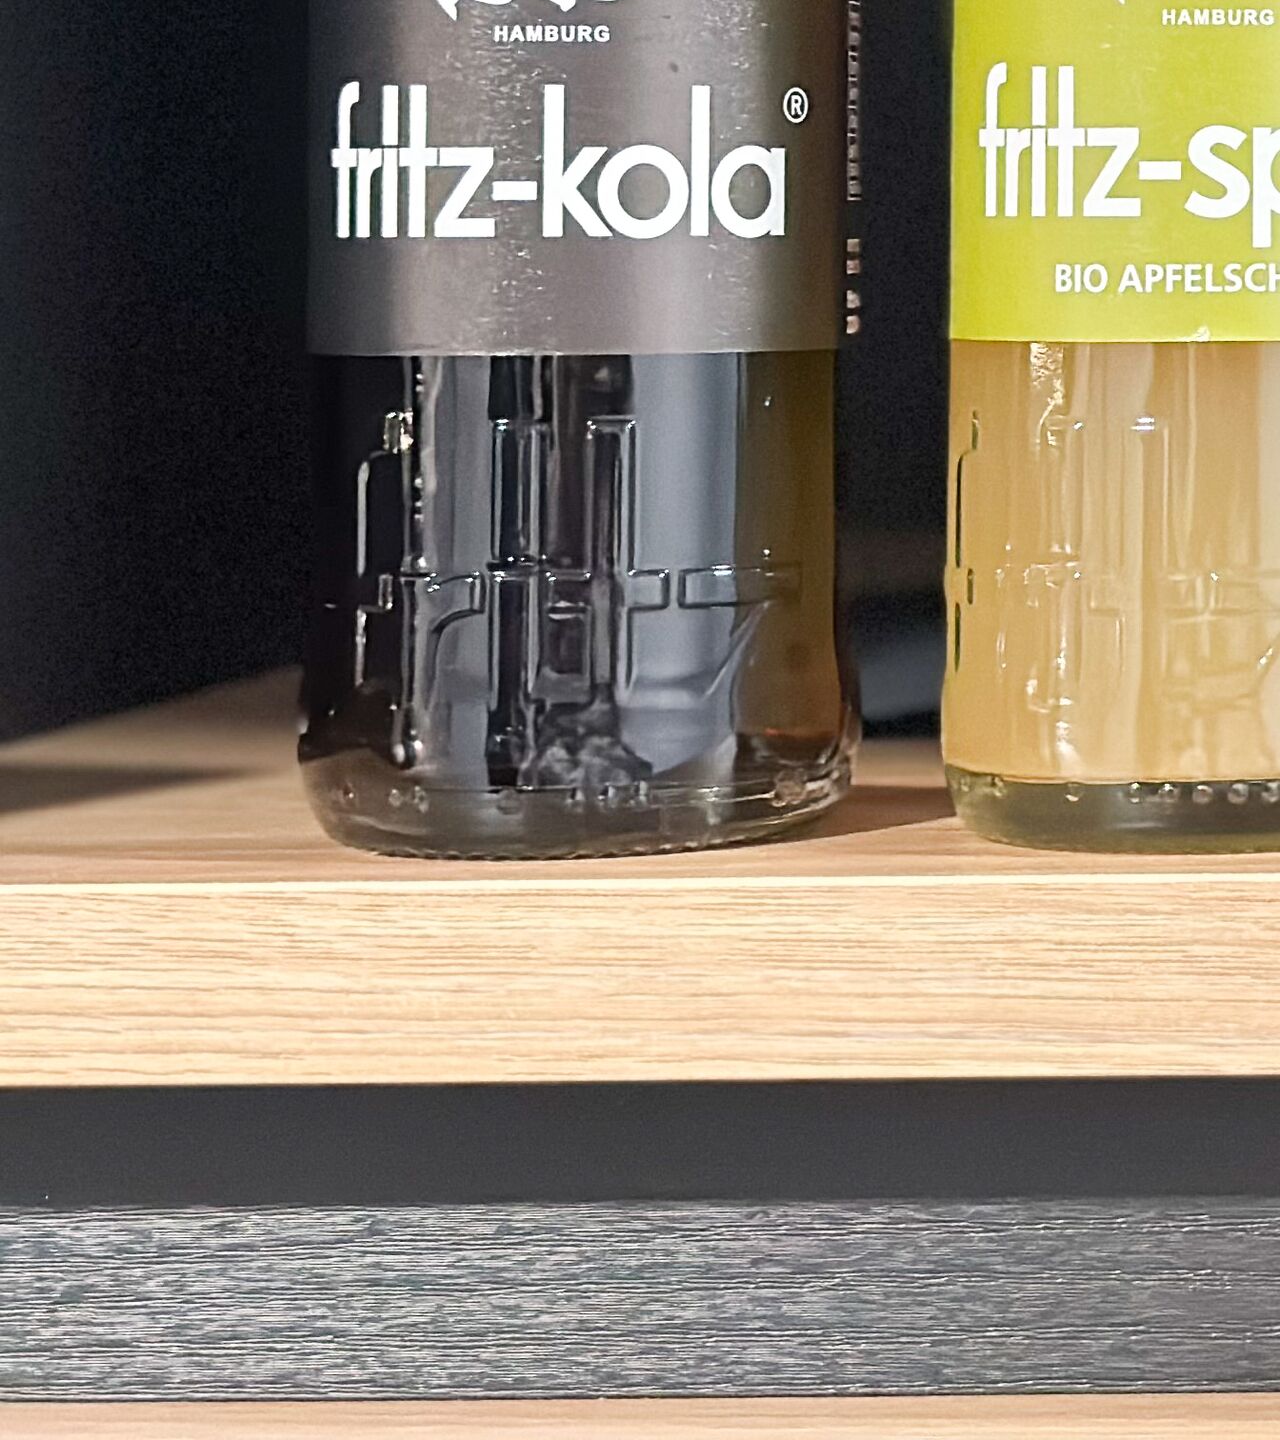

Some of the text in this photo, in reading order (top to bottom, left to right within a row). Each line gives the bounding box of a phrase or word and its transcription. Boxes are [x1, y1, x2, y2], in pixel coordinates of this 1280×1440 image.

[1162, 8, 1275, 27] HAMBURG
[493, 24, 611, 43] HAMBURG
[331, 81, 786, 238] fritz-kola
[1055, 263, 1108, 293] BIO
